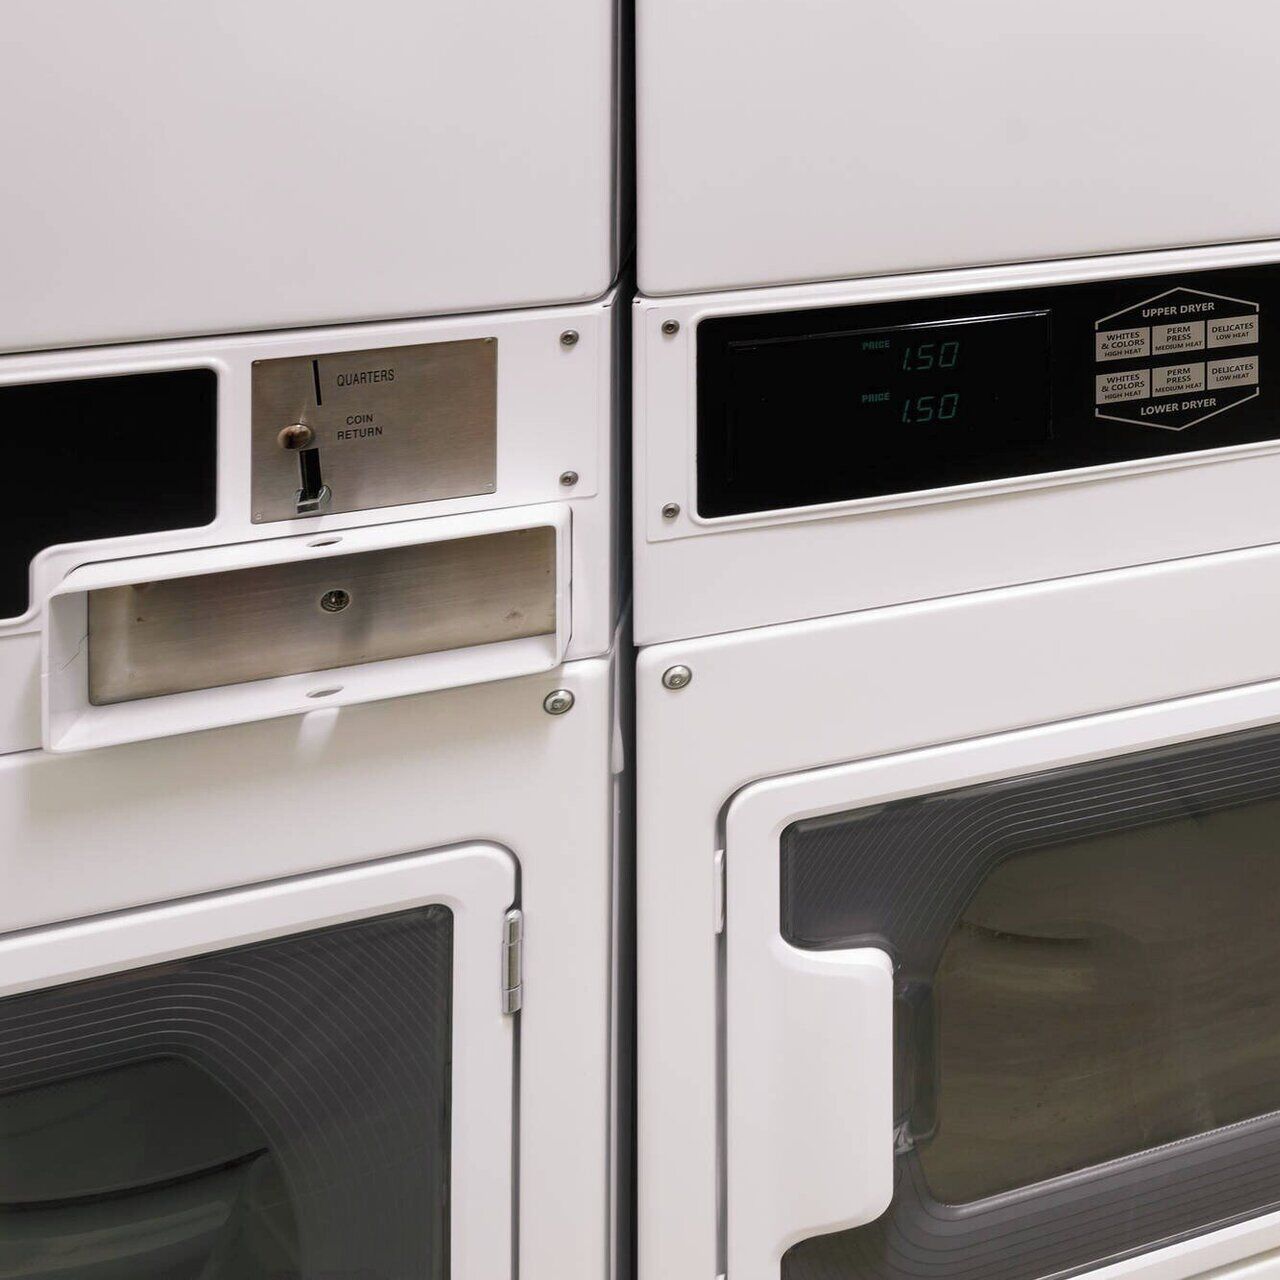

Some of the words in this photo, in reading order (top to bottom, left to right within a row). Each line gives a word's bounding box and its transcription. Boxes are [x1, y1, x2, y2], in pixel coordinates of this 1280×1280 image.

[1142, 306, 1177, 318] UPPER
[1180, 302, 1215, 315] DRYER
[1167, 326, 1191, 334] PERM
[1211, 322, 1254, 333] DELICATES
[1107, 332, 1140, 341] WHITES
[1166, 333, 1191, 342] PRESS
[1232, 331, 1250, 339] HEAT
[1111, 339, 1145, 349] COLORS
[1155, 343, 1184, 351] MEDIUM
[1185, 340, 1203, 348] HEAT
[902, 342, 959, 371] 1.50
[1124, 348, 1142, 356] HEAT
[1167, 368, 1191, 376] PERM
[1211, 363, 1254, 375] DELICATES
[336, 369, 395, 387] QUARTERS
[1107, 374, 1140, 384] WHITES
[1166, 375, 1191, 384] PRESS
[1111, 380, 1145, 391] COLORS
[1155, 385, 1184, 393] MEDIUM
[862, 392, 891, 403] PRICE
[902, 394, 959, 423] 1.50
[1141, 402, 1179, 416] LOWER
[1182, 397, 1217, 410] DRYER
[346, 414, 373, 425] COIN
[337, 426, 383, 441] RETURN
